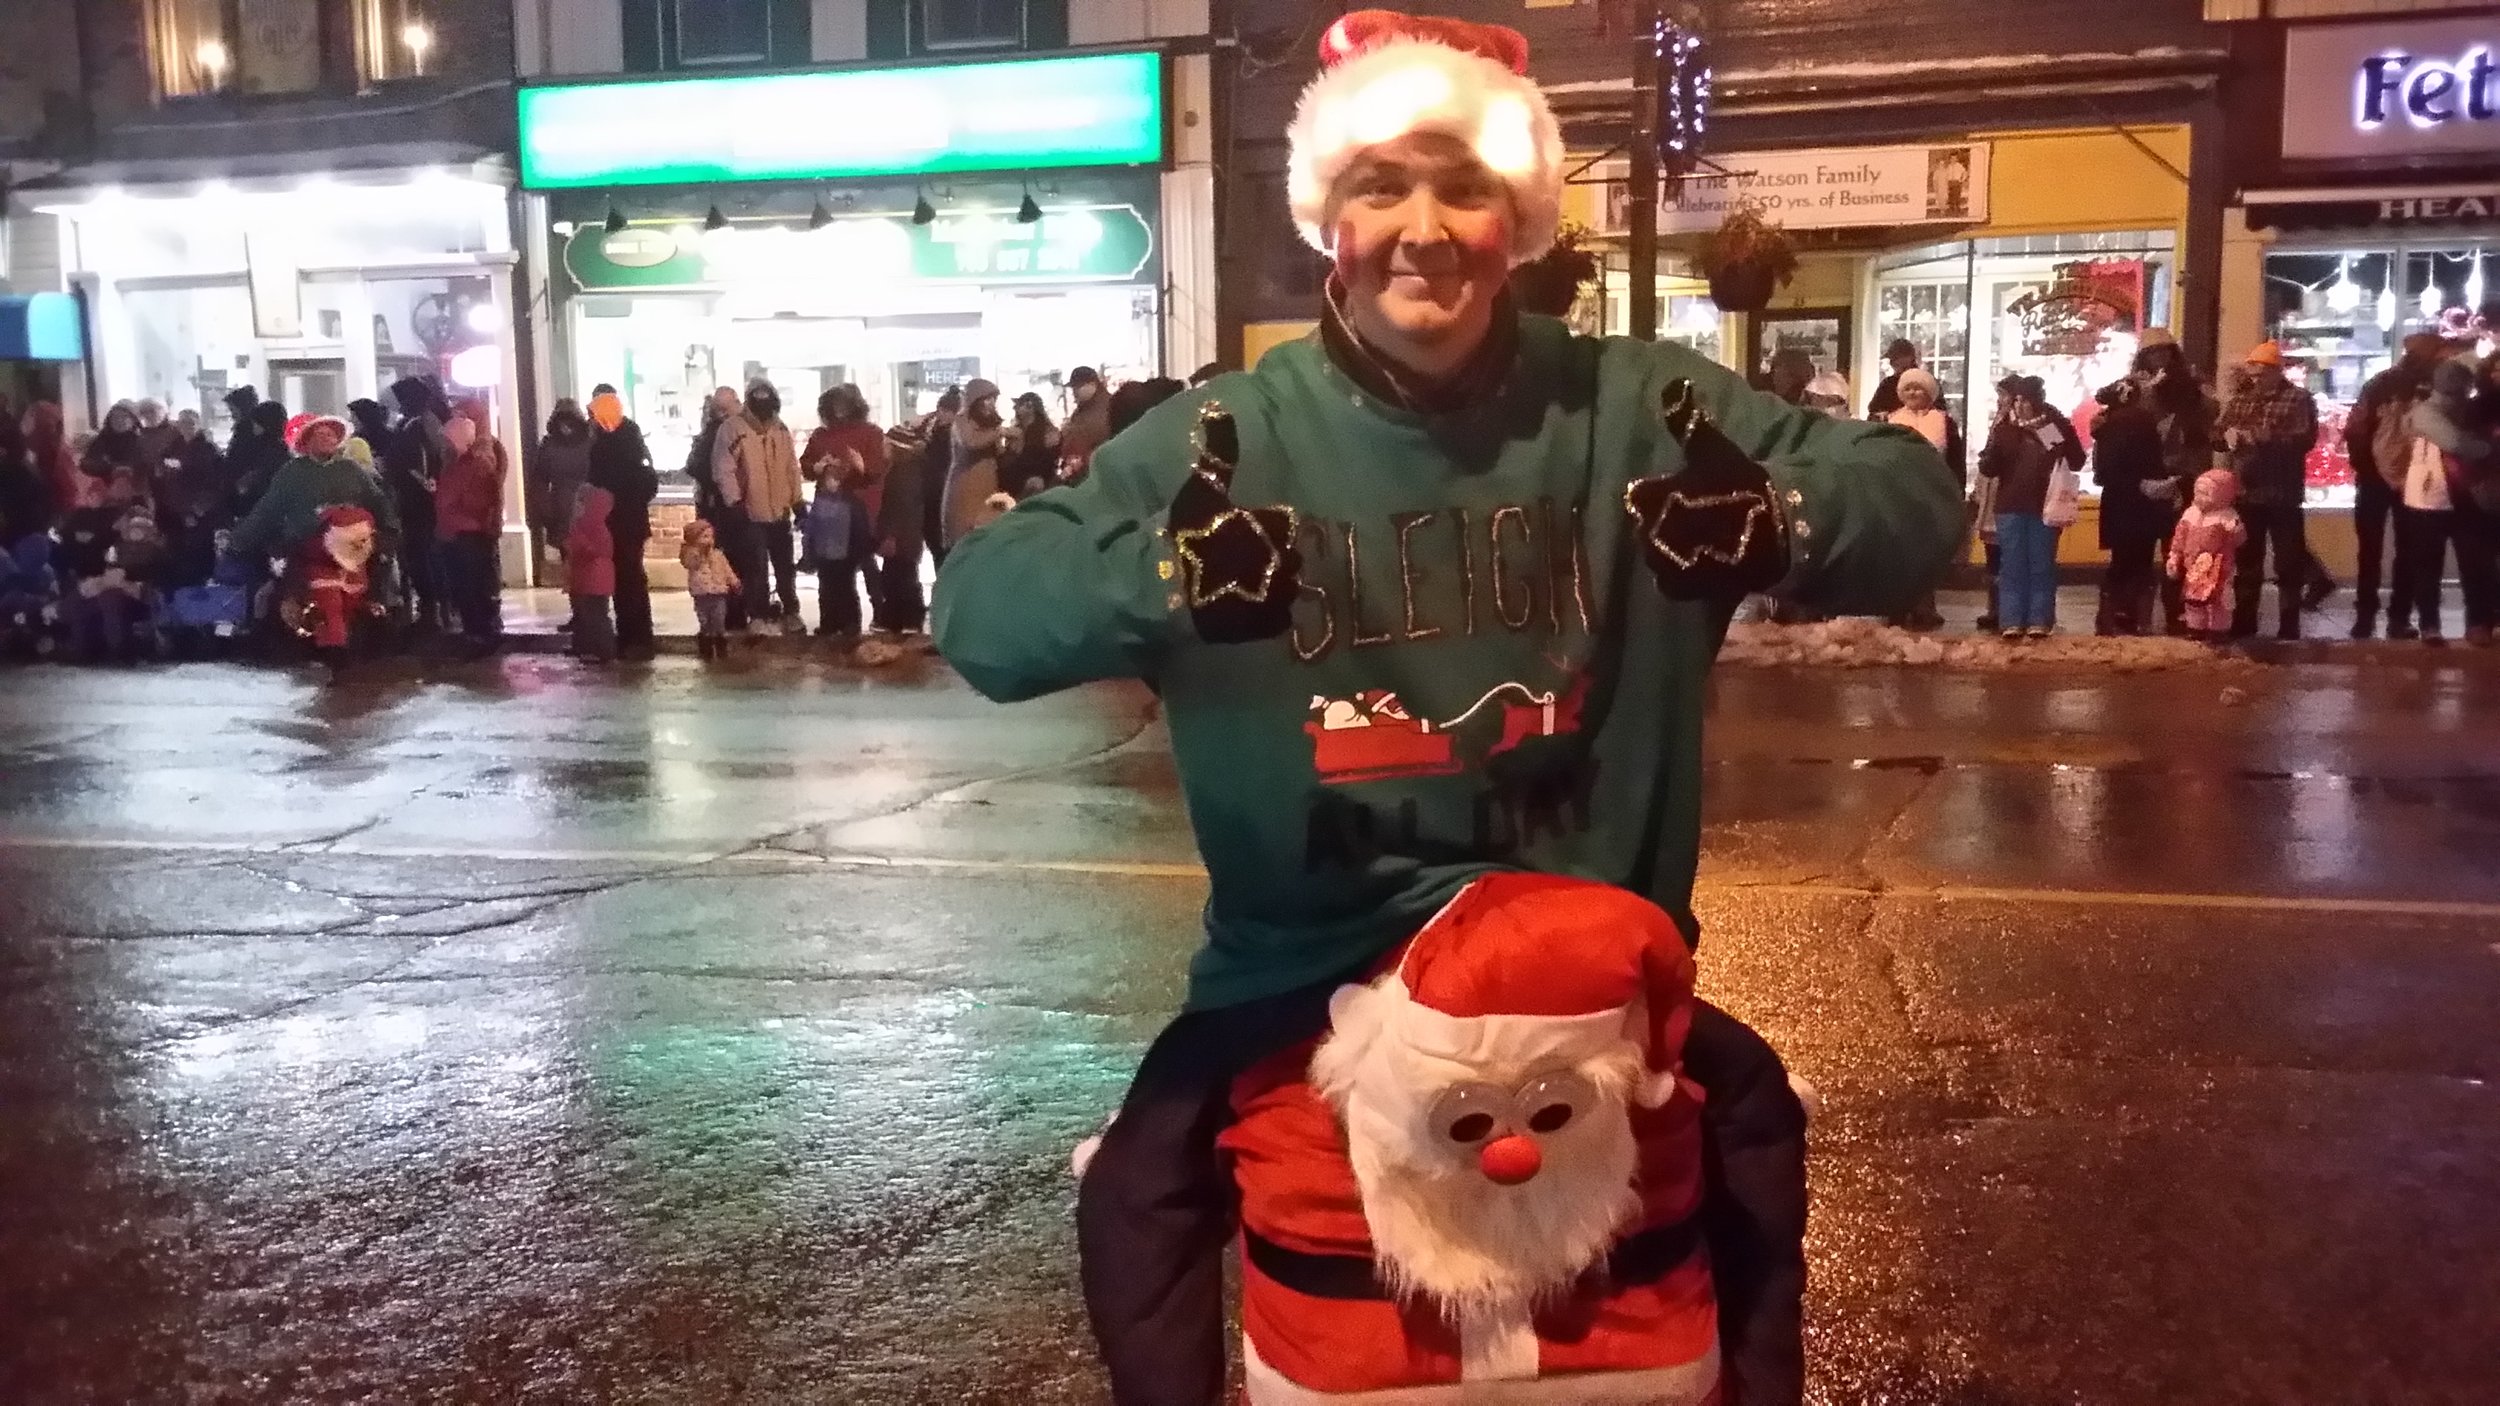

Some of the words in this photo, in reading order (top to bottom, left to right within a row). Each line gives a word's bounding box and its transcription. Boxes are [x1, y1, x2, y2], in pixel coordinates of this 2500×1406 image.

[2361, 52, 2497, 121] Fet
[1694, 171, 1728, 189] The
[1735, 169, 1809, 187] Watson
[1815, 164, 1882, 187] Family
[1787, 197, 1815, 211] yrs.
[1819, 192, 1836, 208] of
[1839, 189, 1910, 206] Business
[2379, 197, 2500, 219] HEA
[925, 370, 960, 384] HERE
[1291, 498, 1596, 661] SLEIGH
